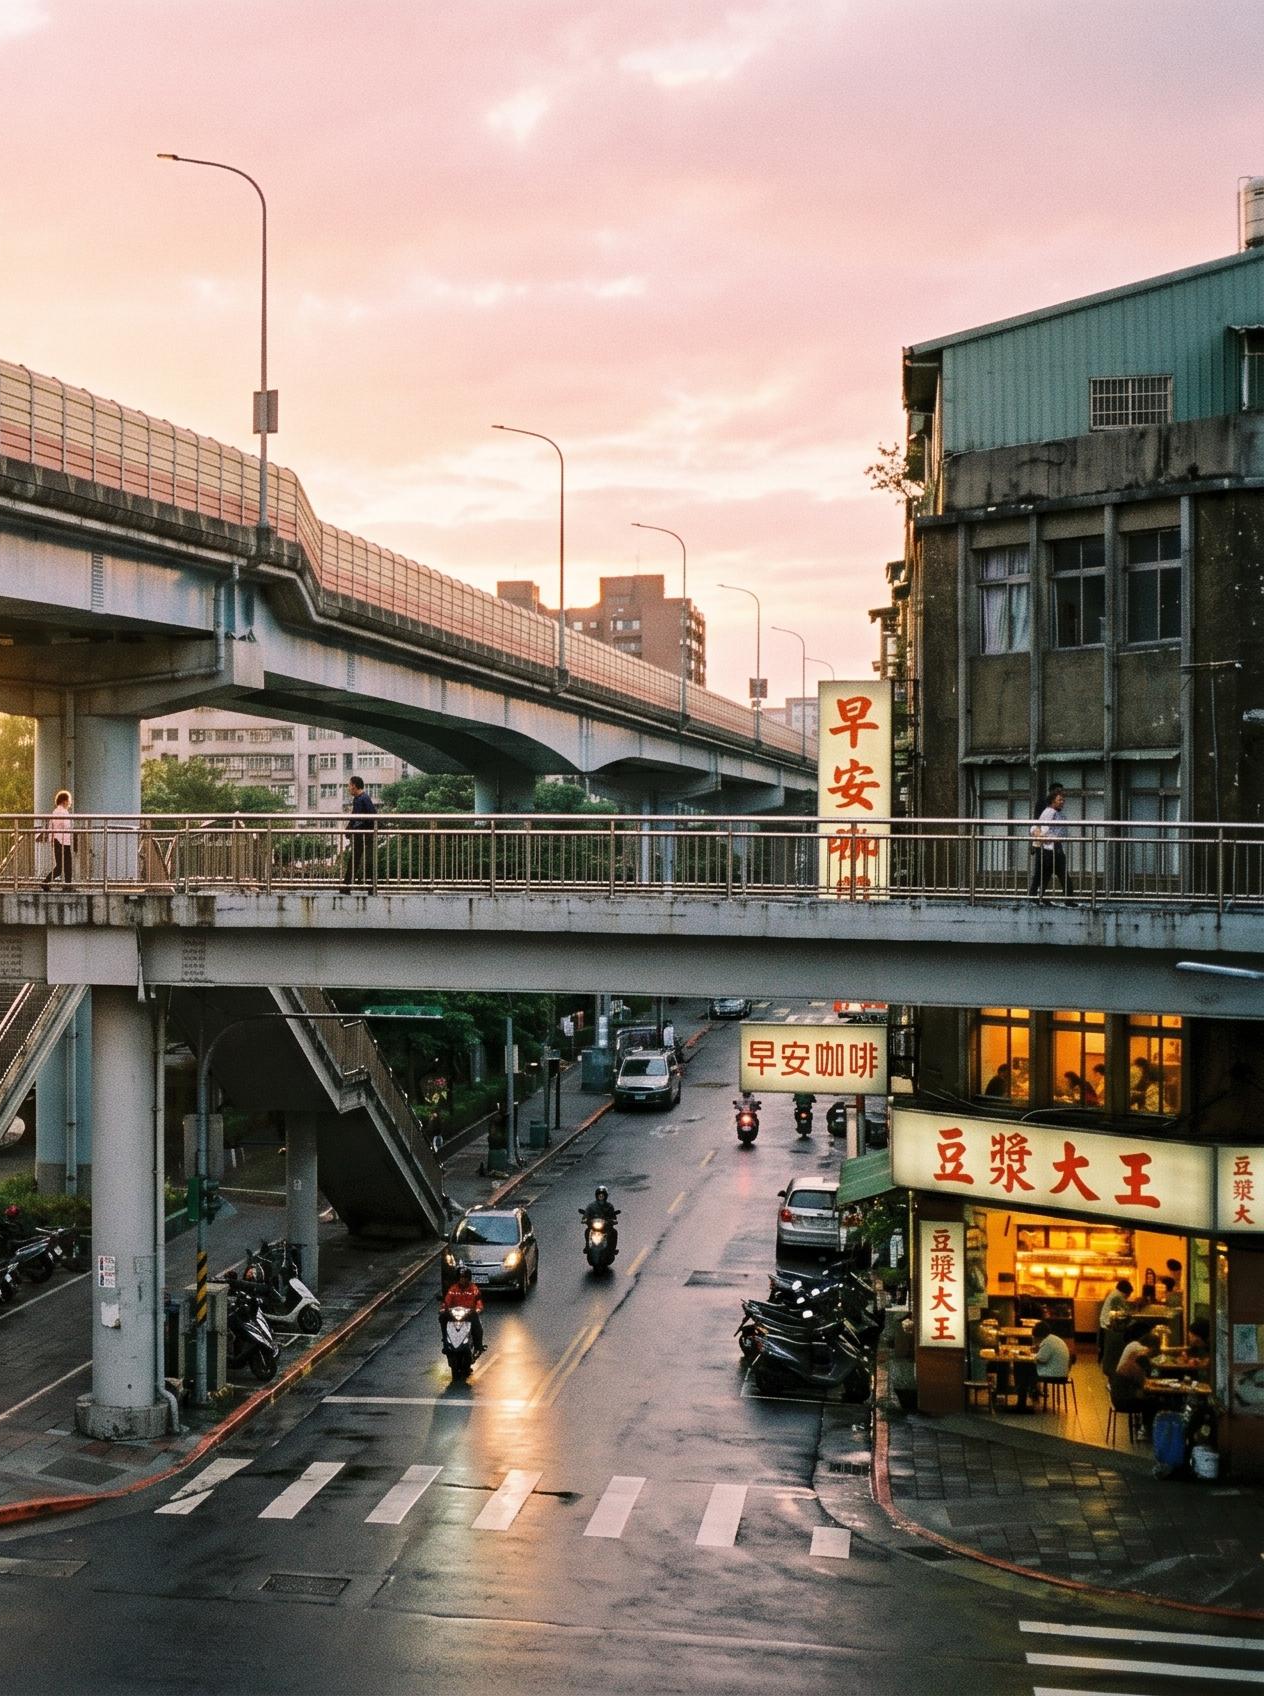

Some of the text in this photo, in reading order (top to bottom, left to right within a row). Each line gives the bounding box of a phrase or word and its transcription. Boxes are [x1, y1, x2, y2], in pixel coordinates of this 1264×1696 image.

[747, 1040, 879, 1079] 早安咖啡
[933, 1127, 1162, 1209] 豆漿大王
[929, 1228, 958, 1342] 豆漿大王
